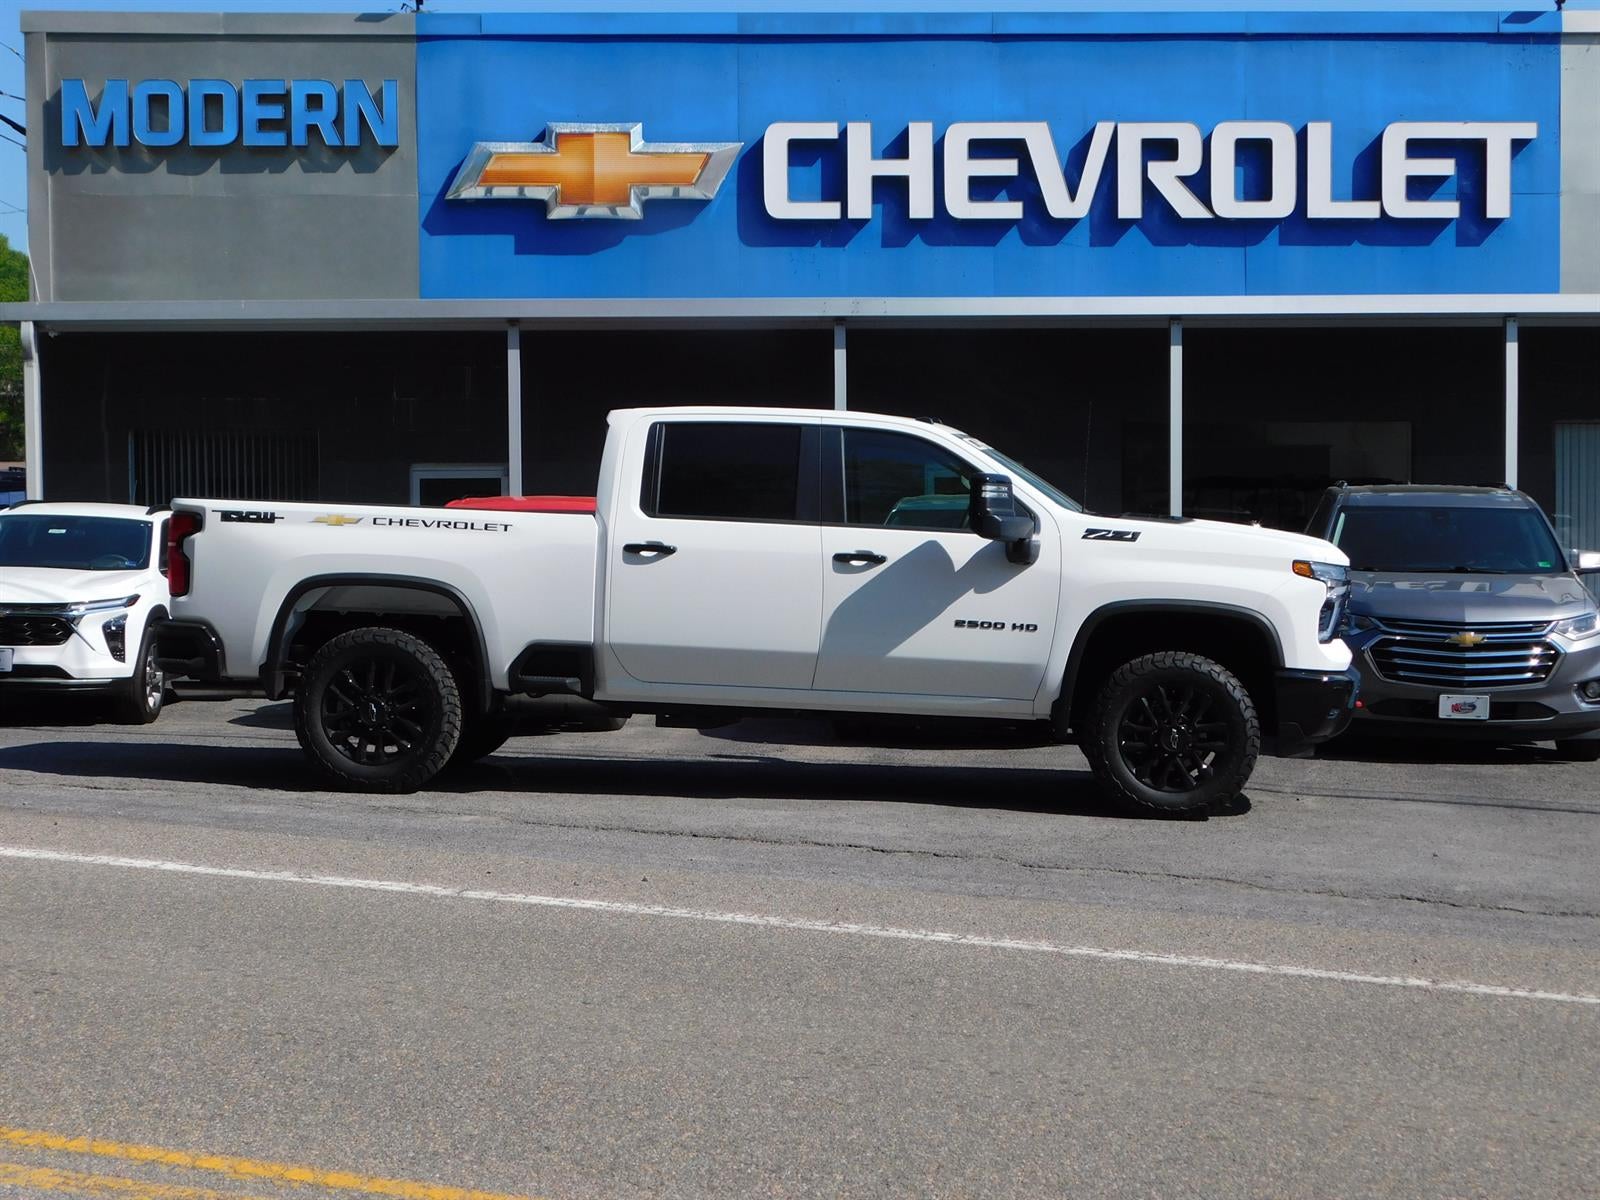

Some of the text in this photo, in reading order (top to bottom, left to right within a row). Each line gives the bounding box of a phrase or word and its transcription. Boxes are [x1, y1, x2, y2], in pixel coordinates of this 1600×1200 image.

[61, 79, 399, 147] MODERN
[763, 121, 1538, 220] CHEVROLET
[372, 517, 513, 532] CHEVROLET
[954, 619, 1039, 633] 2500 HD
